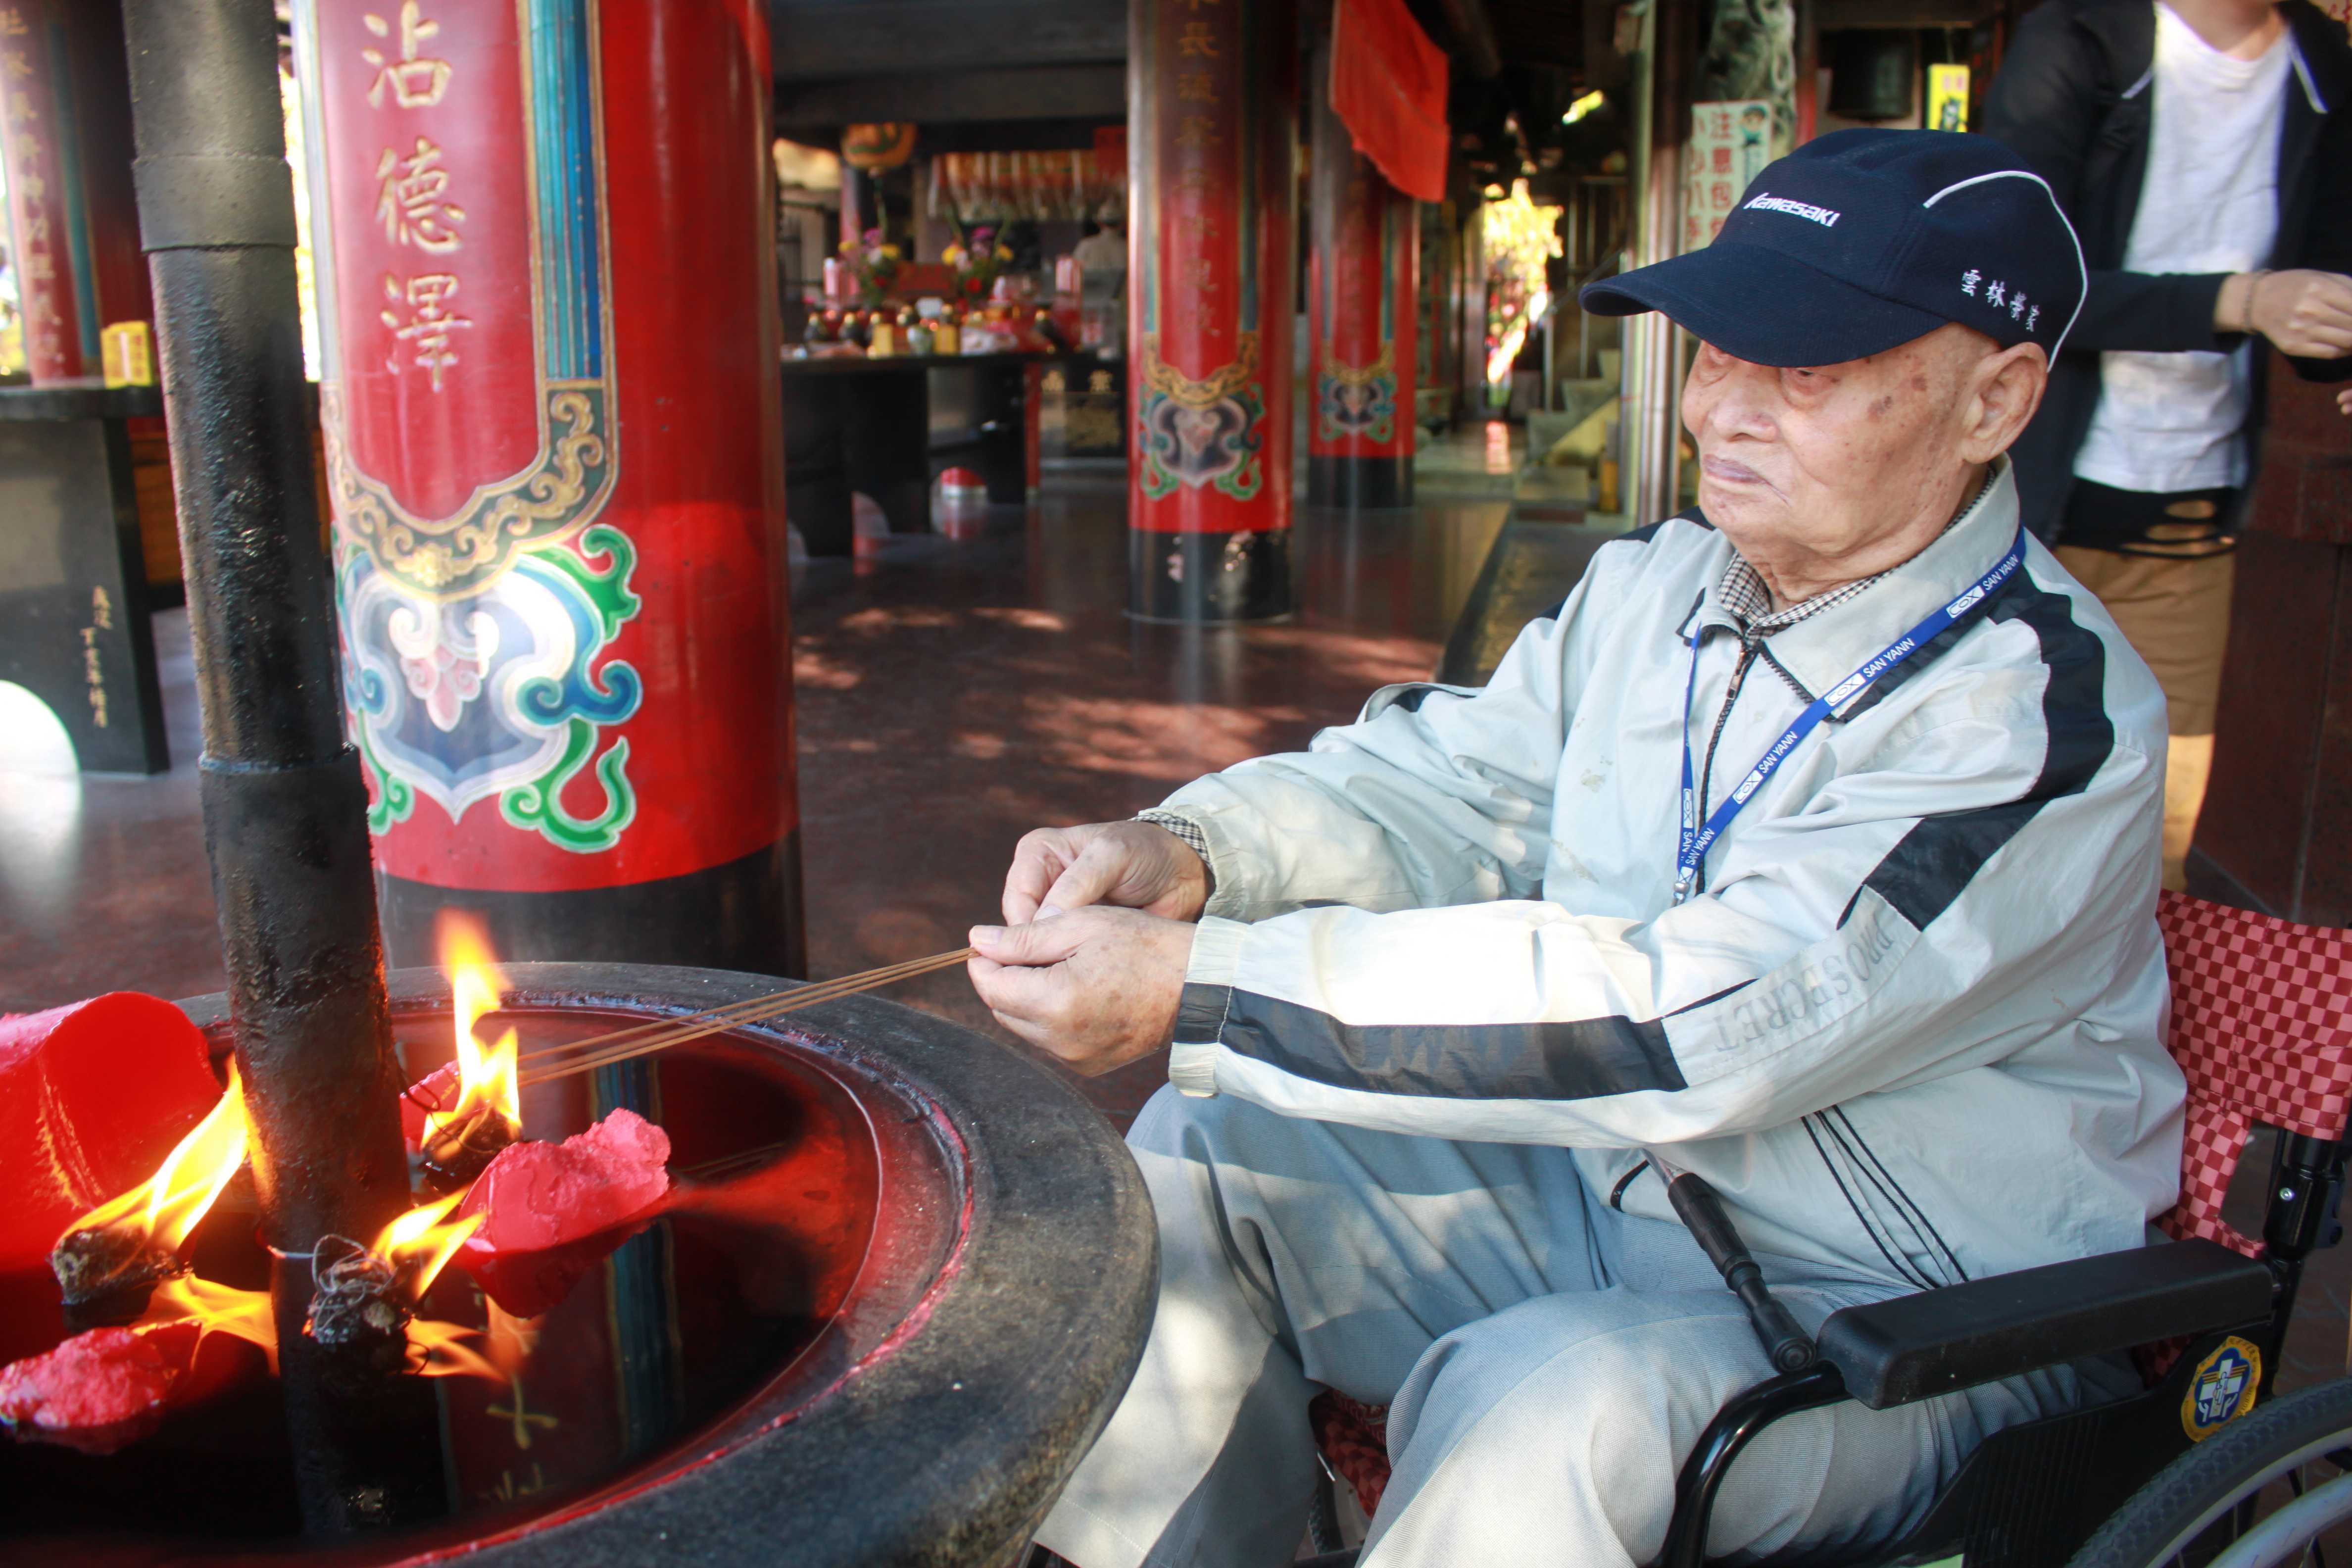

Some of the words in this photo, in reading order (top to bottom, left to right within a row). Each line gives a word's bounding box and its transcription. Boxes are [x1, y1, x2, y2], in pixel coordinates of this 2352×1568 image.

[361, 0, 474, 393] 沾德澤
[1743, 192, 1841, 227] Kawasaki
[1982, 571, 2002, 591] SAN
[1999, 554, 2019, 576] YANN
[1862, 658, 1887, 678] SAN
[1883, 637, 1915, 662] YANN
[1758, 753, 1778, 774] SAN
[1773, 731, 1798, 759] YANN
[1682, 832, 1693, 852] SAN
[1685, 849, 1701, 865] SAN
[1693, 827, 1715, 851] YANN
